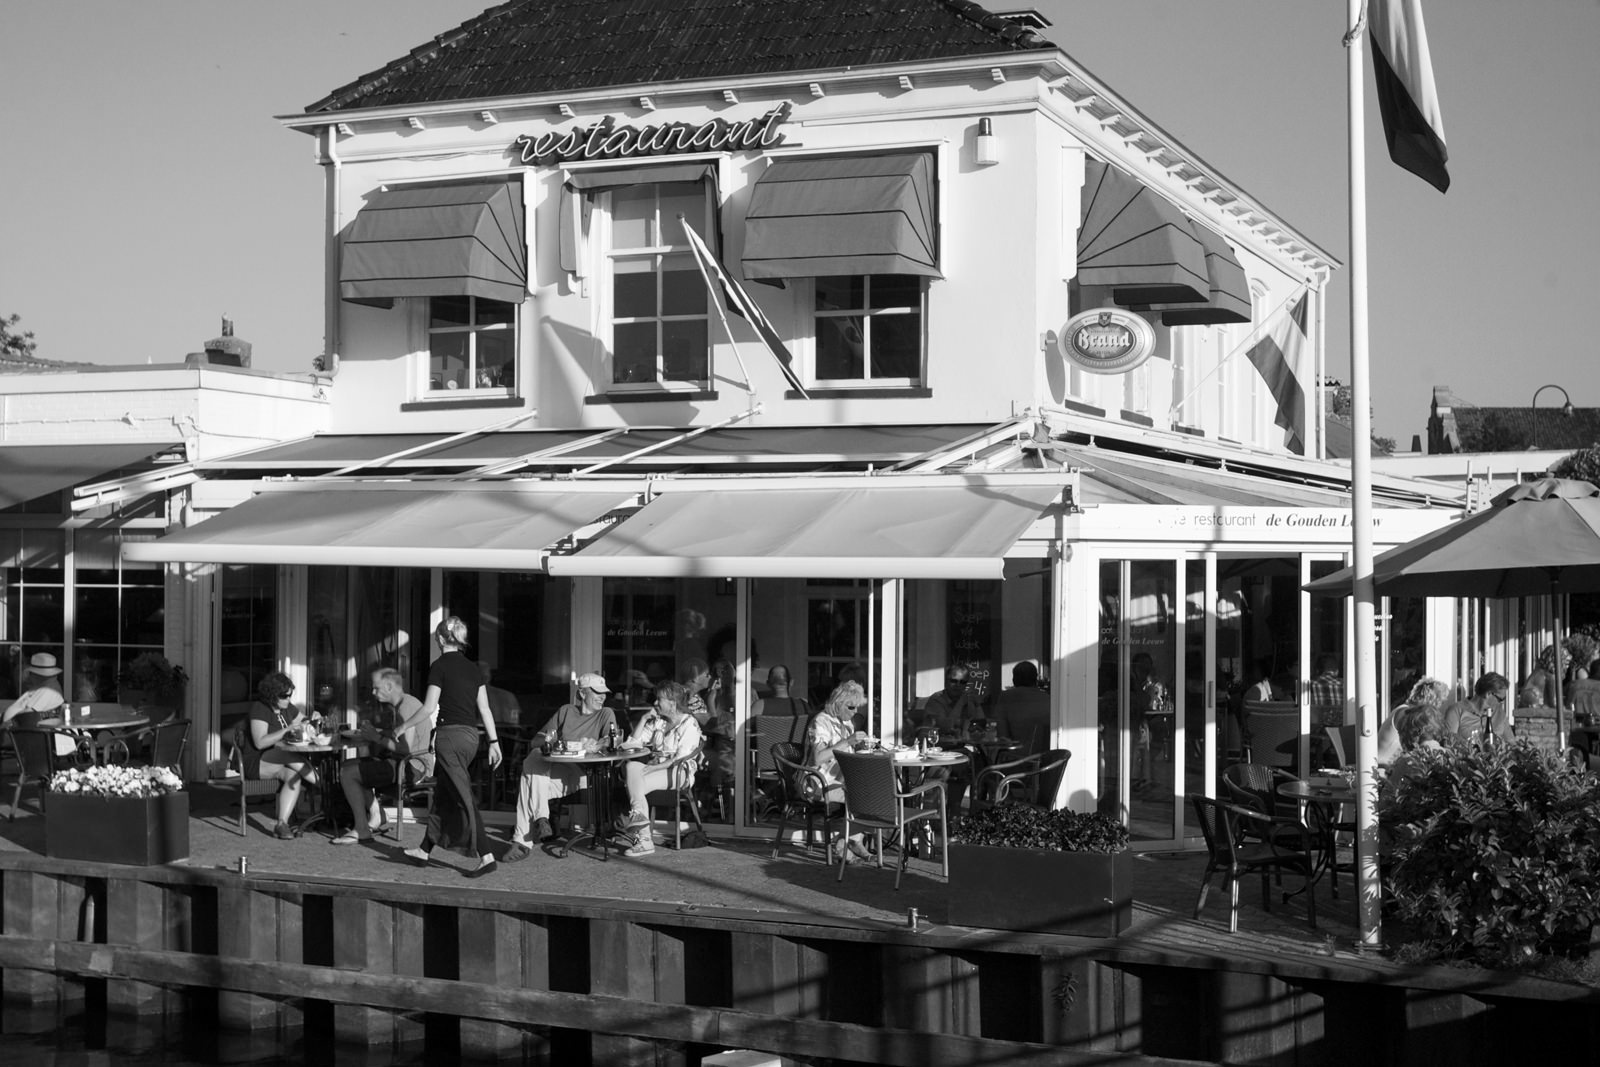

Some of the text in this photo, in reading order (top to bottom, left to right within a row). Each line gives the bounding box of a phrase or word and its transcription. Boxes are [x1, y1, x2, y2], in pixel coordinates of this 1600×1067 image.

[516, 101, 792, 165] restaurant
[1078, 328, 1131, 350] Brand
[1265, 513, 1282, 528] de
[1286, 513, 1337, 528] Gouden
